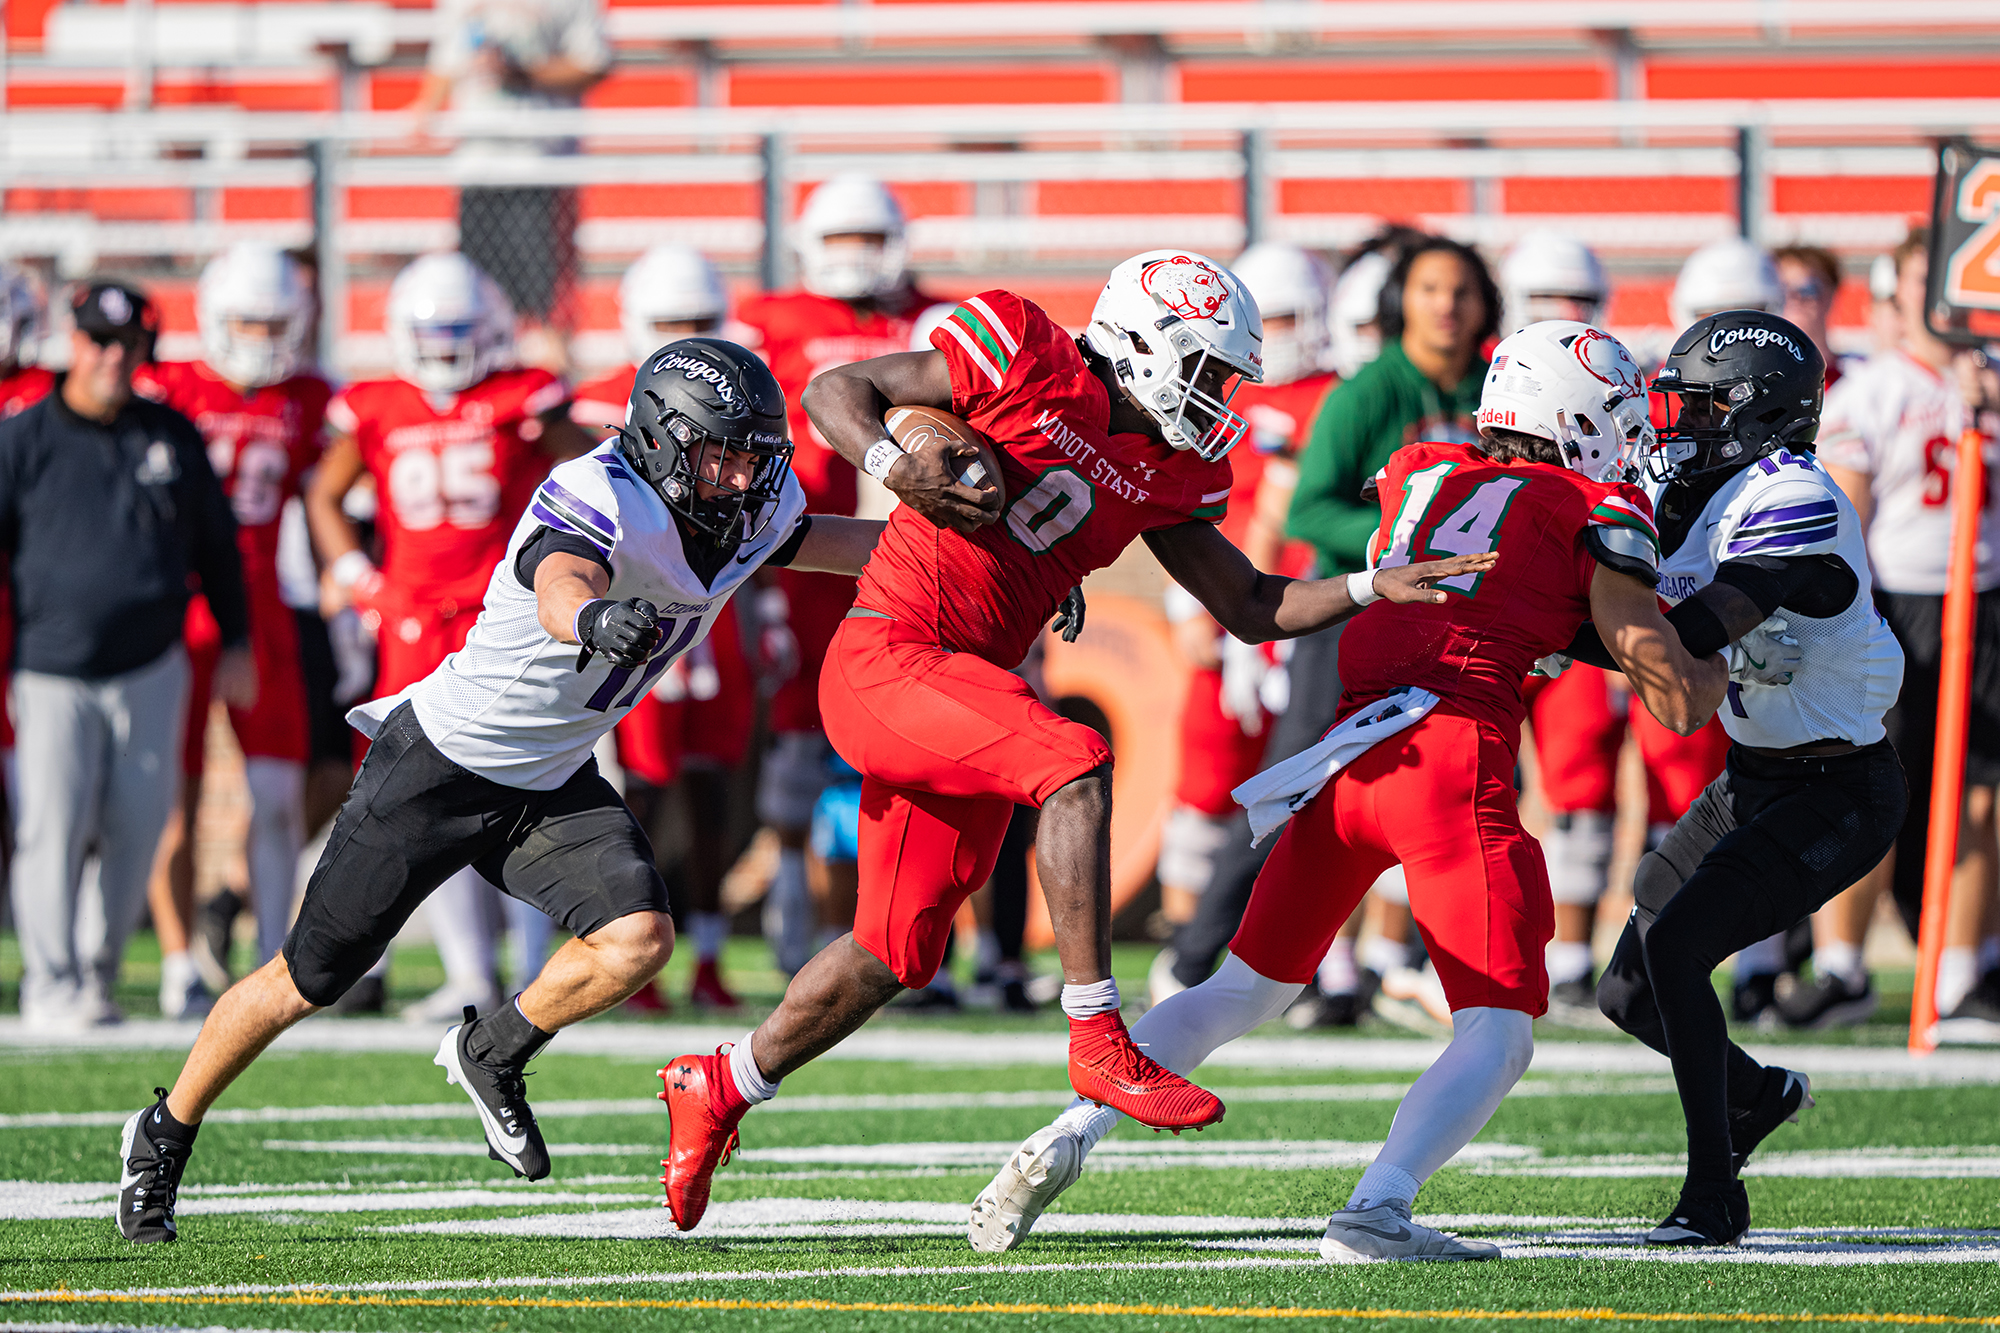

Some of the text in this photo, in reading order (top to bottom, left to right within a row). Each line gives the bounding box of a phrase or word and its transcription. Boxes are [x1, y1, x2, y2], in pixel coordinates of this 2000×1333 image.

[1943, 157, 2000, 308] 2
[1711, 328, 1804, 362] Cougars
[653, 353, 734, 402] Cougars
[1031, 409, 1096, 465] MINOT
[1479, 408, 1516, 426] ddell
[1091, 458, 1149, 504] STATE
[1001, 465, 1096, 557] 0
[1374, 460, 1532, 600] 14
[1656, 572, 1697, 600] OUGARS
[1143, 1083, 1189, 1093] ARMOUR
